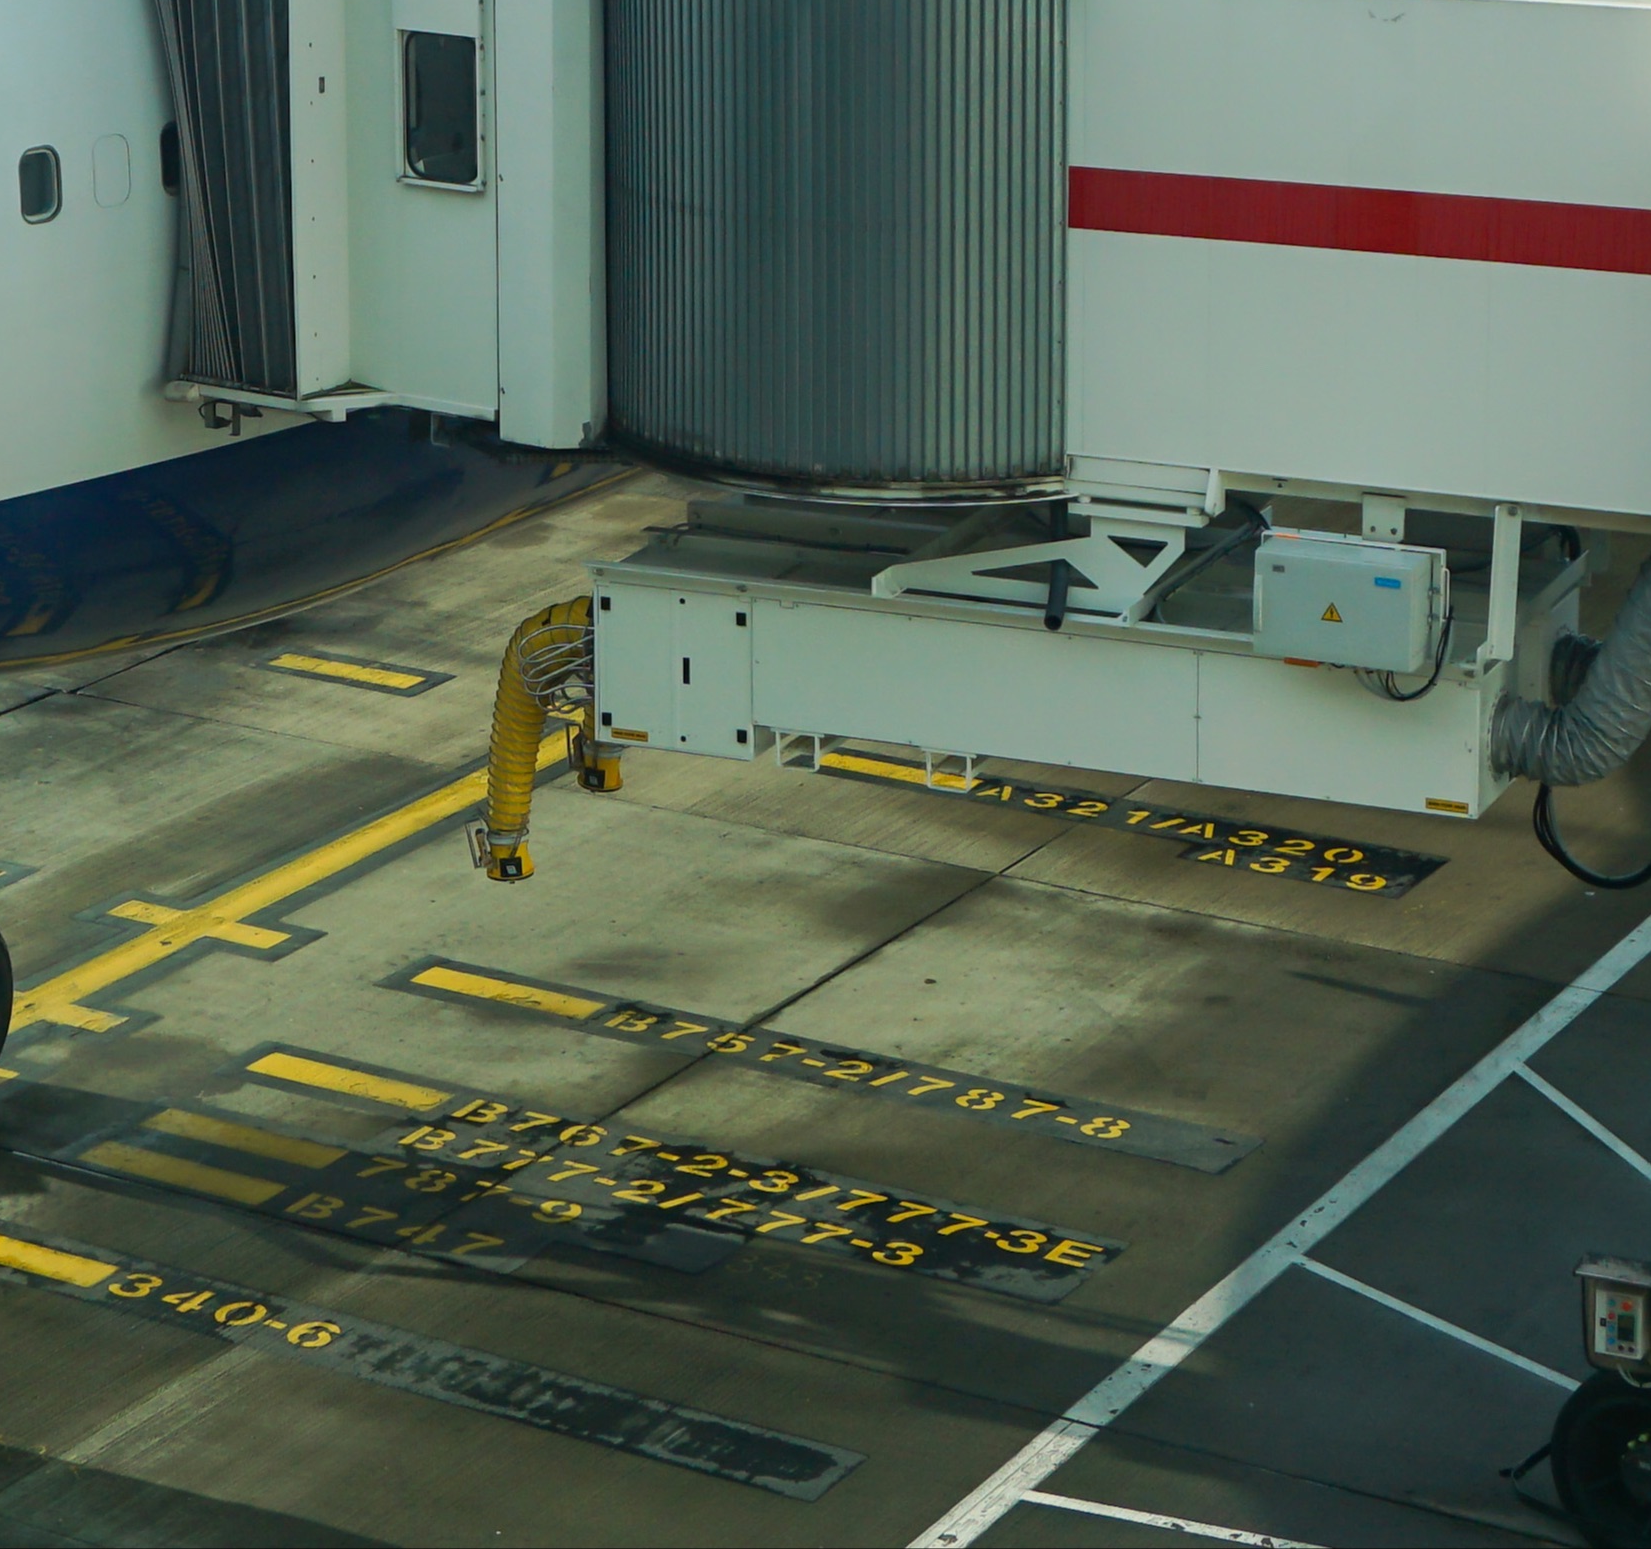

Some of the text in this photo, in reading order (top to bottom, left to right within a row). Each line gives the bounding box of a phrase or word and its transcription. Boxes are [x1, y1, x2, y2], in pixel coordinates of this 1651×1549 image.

[1198, 848, 1388, 891] A319
[356, 1156, 583, 1223] 787-9
[285, 1193, 505, 1254] B747
[108, 1273, 342, 1348] 340-6
